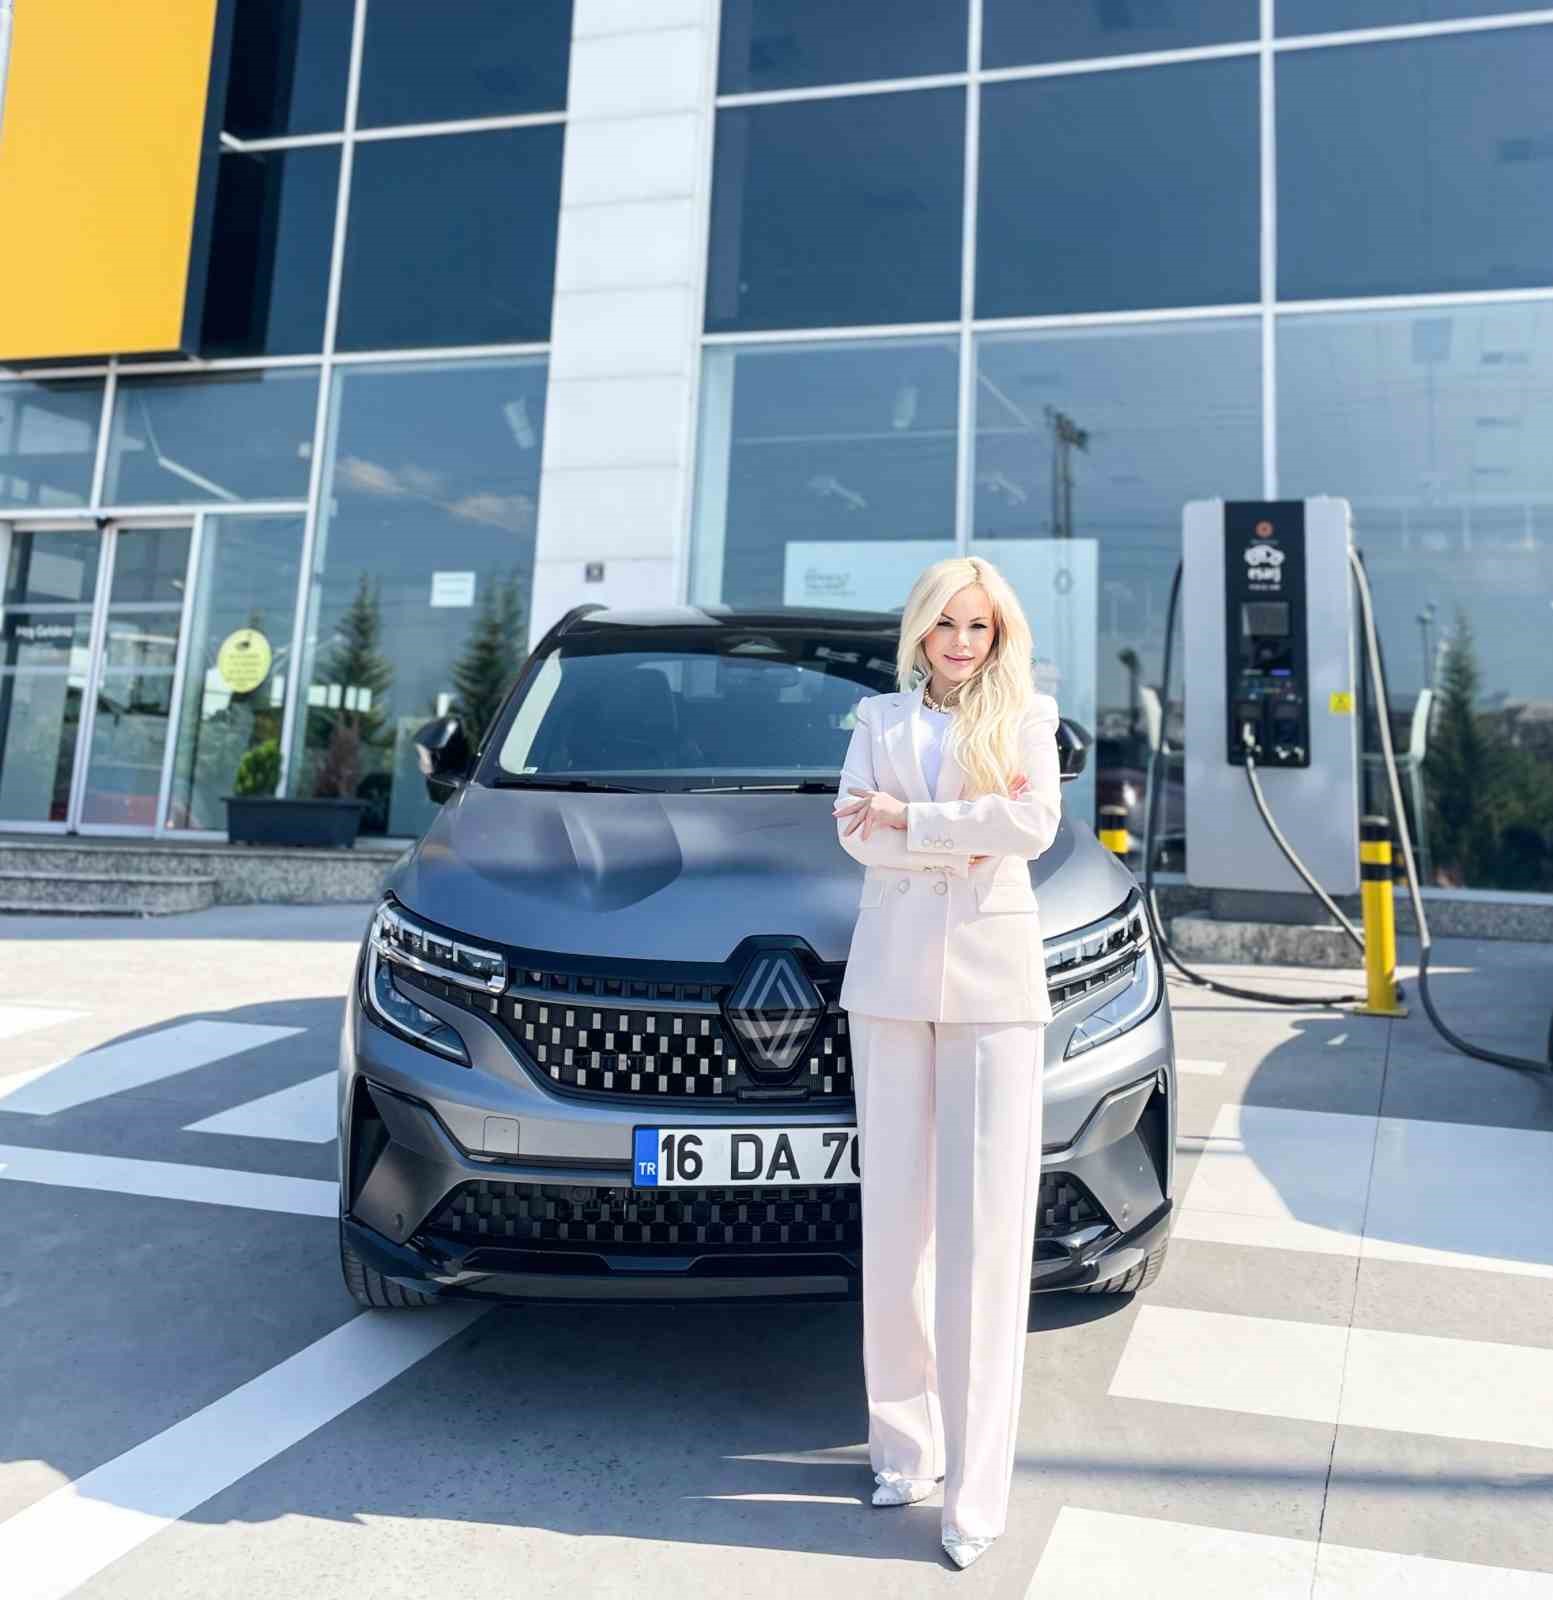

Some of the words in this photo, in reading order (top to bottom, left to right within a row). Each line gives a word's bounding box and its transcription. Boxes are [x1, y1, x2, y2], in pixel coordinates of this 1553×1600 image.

[639, 1162, 656, 1176] TR
[661, 1133, 703, 1181] 16
[731, 1133, 800, 1180] DA
